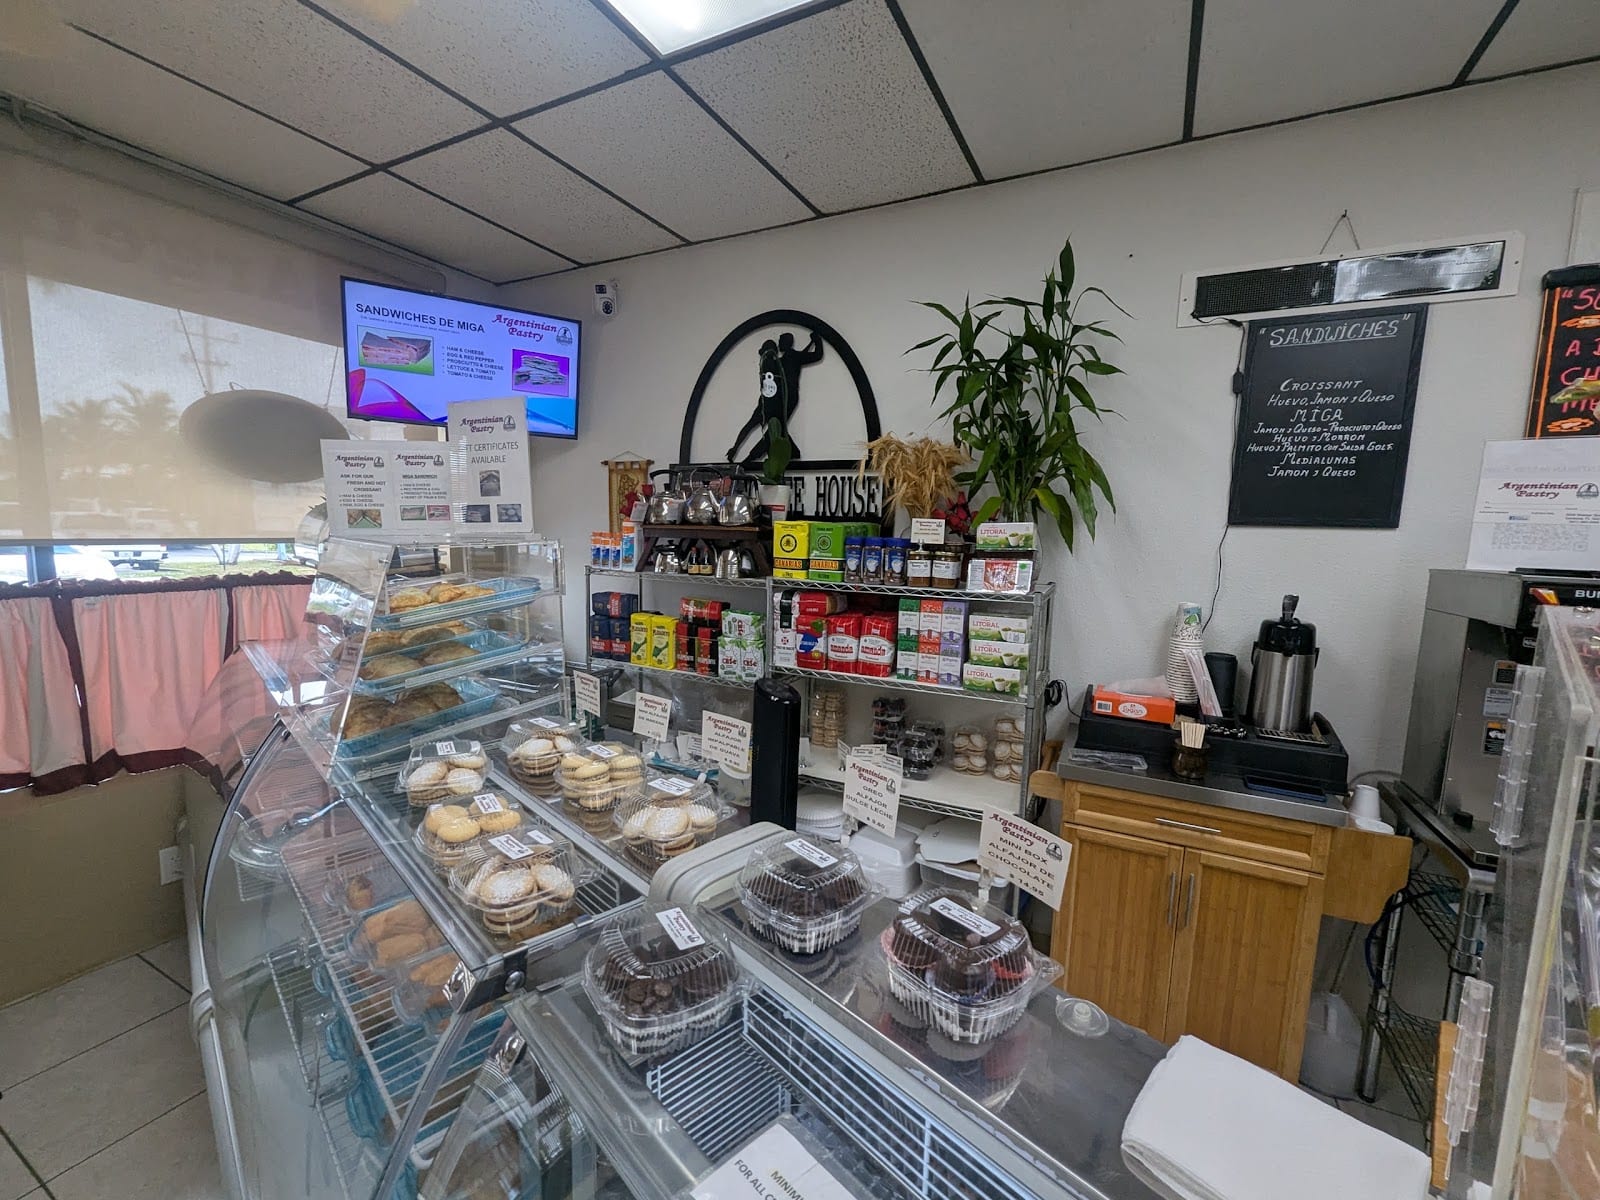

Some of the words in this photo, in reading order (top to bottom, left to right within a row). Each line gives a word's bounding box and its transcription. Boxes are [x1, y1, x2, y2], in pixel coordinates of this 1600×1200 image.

[356, 303, 436, 325] SANDWICHES
[439, 317, 454, 328] DE
[457, 320, 485, 333] MIGA
[491, 314, 557, 332] Argentinian
[508, 327, 543, 342] Pastry
[475, 355, 495, 363] PEPPER
[447, 370, 468, 378] TOMATO
[1280, 377, 1363, 392] CROISSANT
[1310, 392, 1349, 405] JAMON
[1359, 389, 1395, 403] QUESO
[1290, 406, 1343, 422] MIGA
[460, 416, 504, 427] Argentinian
[1253, 422, 1285, 434] JAMON
[1293, 423, 1321, 433] QUESO
[1375, 421, 1402, 431] QUESO
[470, 425, 494, 434] Pastry
[1272, 434, 1308, 443] HUEVO
[474, 441, 519, 451] CERTIFICATES
[1246, 443, 1275, 452] HUEVO
[1281, 442, 1321, 452] PALMITO
[405, 460, 426, 468] Pastry
[471, 455, 507, 464] AVAILABLE
[1267, 465, 1309, 477] JAMON
[1322, 466, 1356, 477] QUESO
[1498, 481, 1579, 491] Argentinian
[815, 475, 879, 517] HOUSE
[1516, 490, 1560, 500] Pastry
[973, 620, 1000, 628] LITORAL
[974, 645, 1002, 654] LITORAL
[966, 670, 993, 678] LITORAL
[706, 716, 740, 729] Argentinian
[713, 723, 732, 734] Pastry
[715, 732, 741, 743] ALFAJOR
[849, 762, 888, 782] Argentinian
[858, 772, 879, 787] Pastry
[856, 791, 888, 809] ALFAJOR
[846, 794, 869, 808] DULCE
[870, 805, 893, 821] LECHE
[989, 813, 1049, 845] Argentinian
[1002, 826, 1034, 847] Pastry
[999, 837, 1022, 851] MINI
[1024, 849, 1048, 865] BOX
[989, 842, 1037, 869] ALFAJOR
[1039, 868, 1055, 880] DE
[988, 851, 1054, 890] CHOCOLATE
[734, 1159, 753, 1180] FOR
[750, 1178, 766, 1196] ALL
